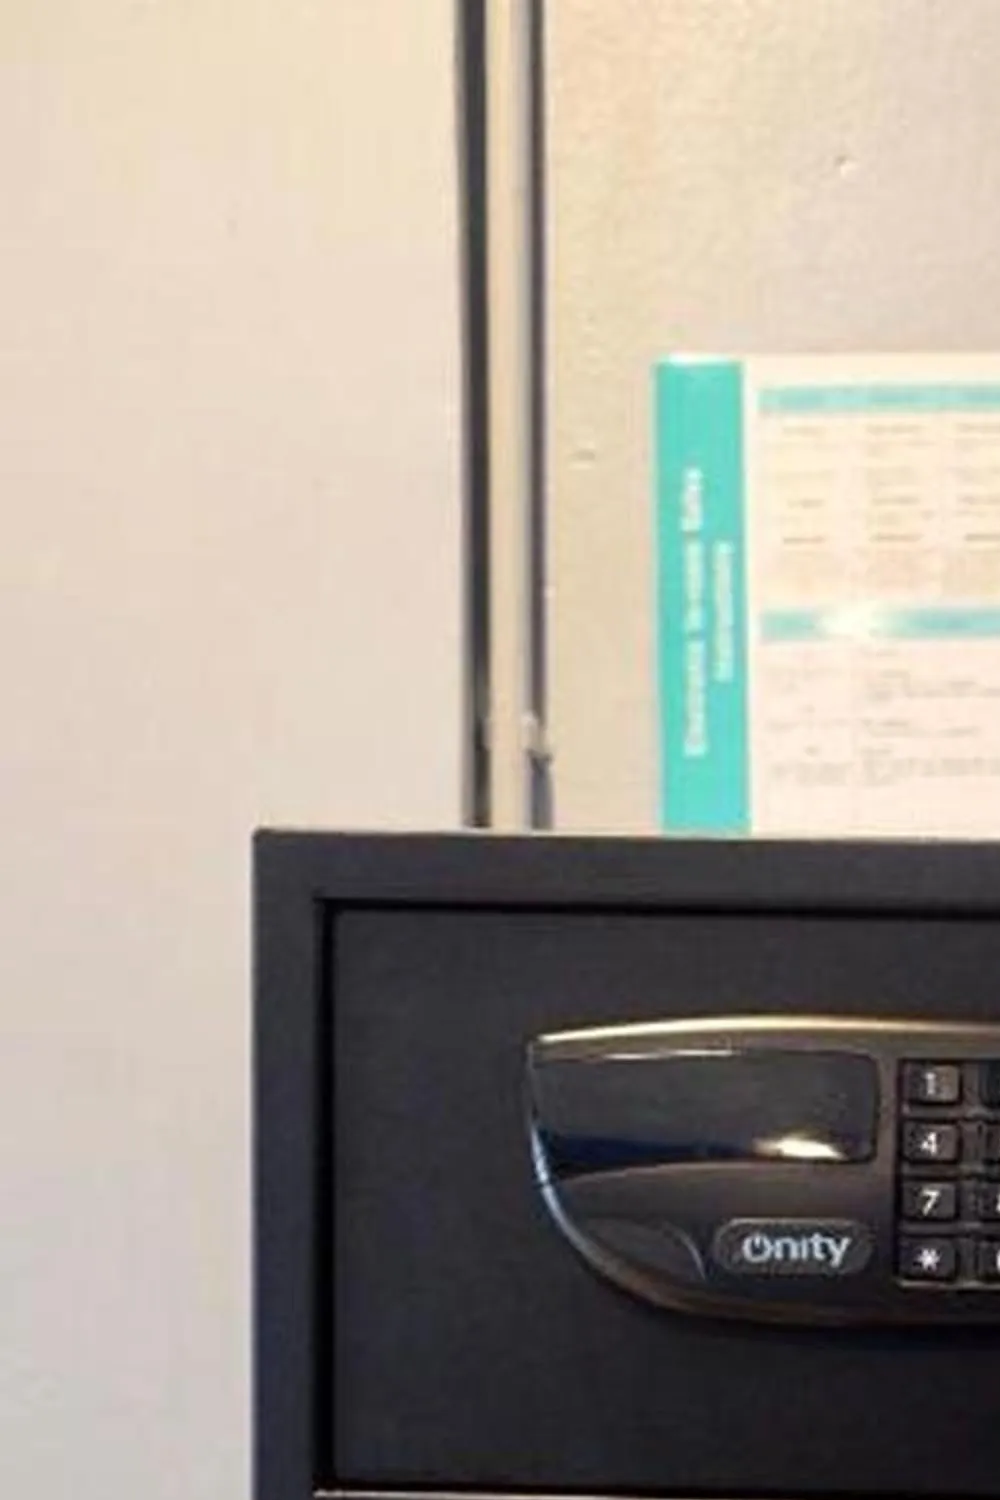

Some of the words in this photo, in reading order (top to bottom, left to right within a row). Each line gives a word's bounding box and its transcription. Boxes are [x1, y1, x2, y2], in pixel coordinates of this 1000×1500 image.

[924, 1071, 937, 1097] 1
[920, 1132, 938, 1154] 4
[922, 1189, 941, 1216] 7
[742, 1231, 852, 1268] Onity
